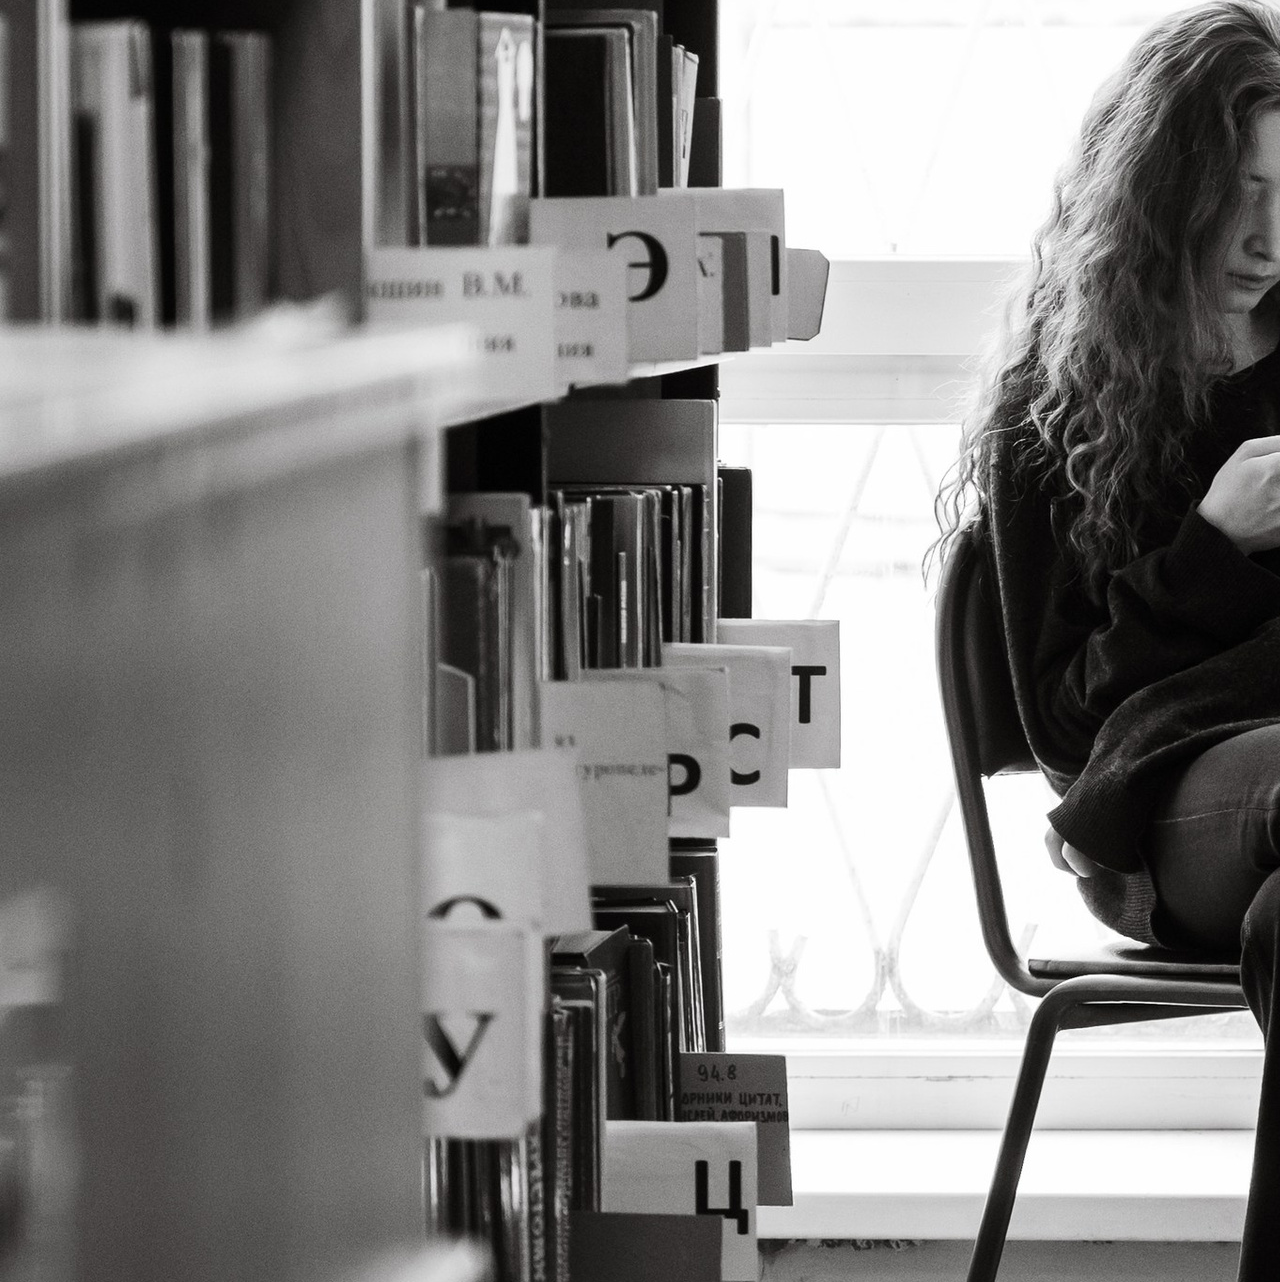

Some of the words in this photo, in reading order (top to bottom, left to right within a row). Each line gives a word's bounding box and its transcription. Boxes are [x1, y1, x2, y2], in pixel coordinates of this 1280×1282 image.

[607, 231, 668, 302] Э
[791, 665, 827, 724] Т
[422, 1013, 496, 1098] У
[697, 1063, 738, 1083] 94.8
[695, 1160, 749, 1236] Ц
